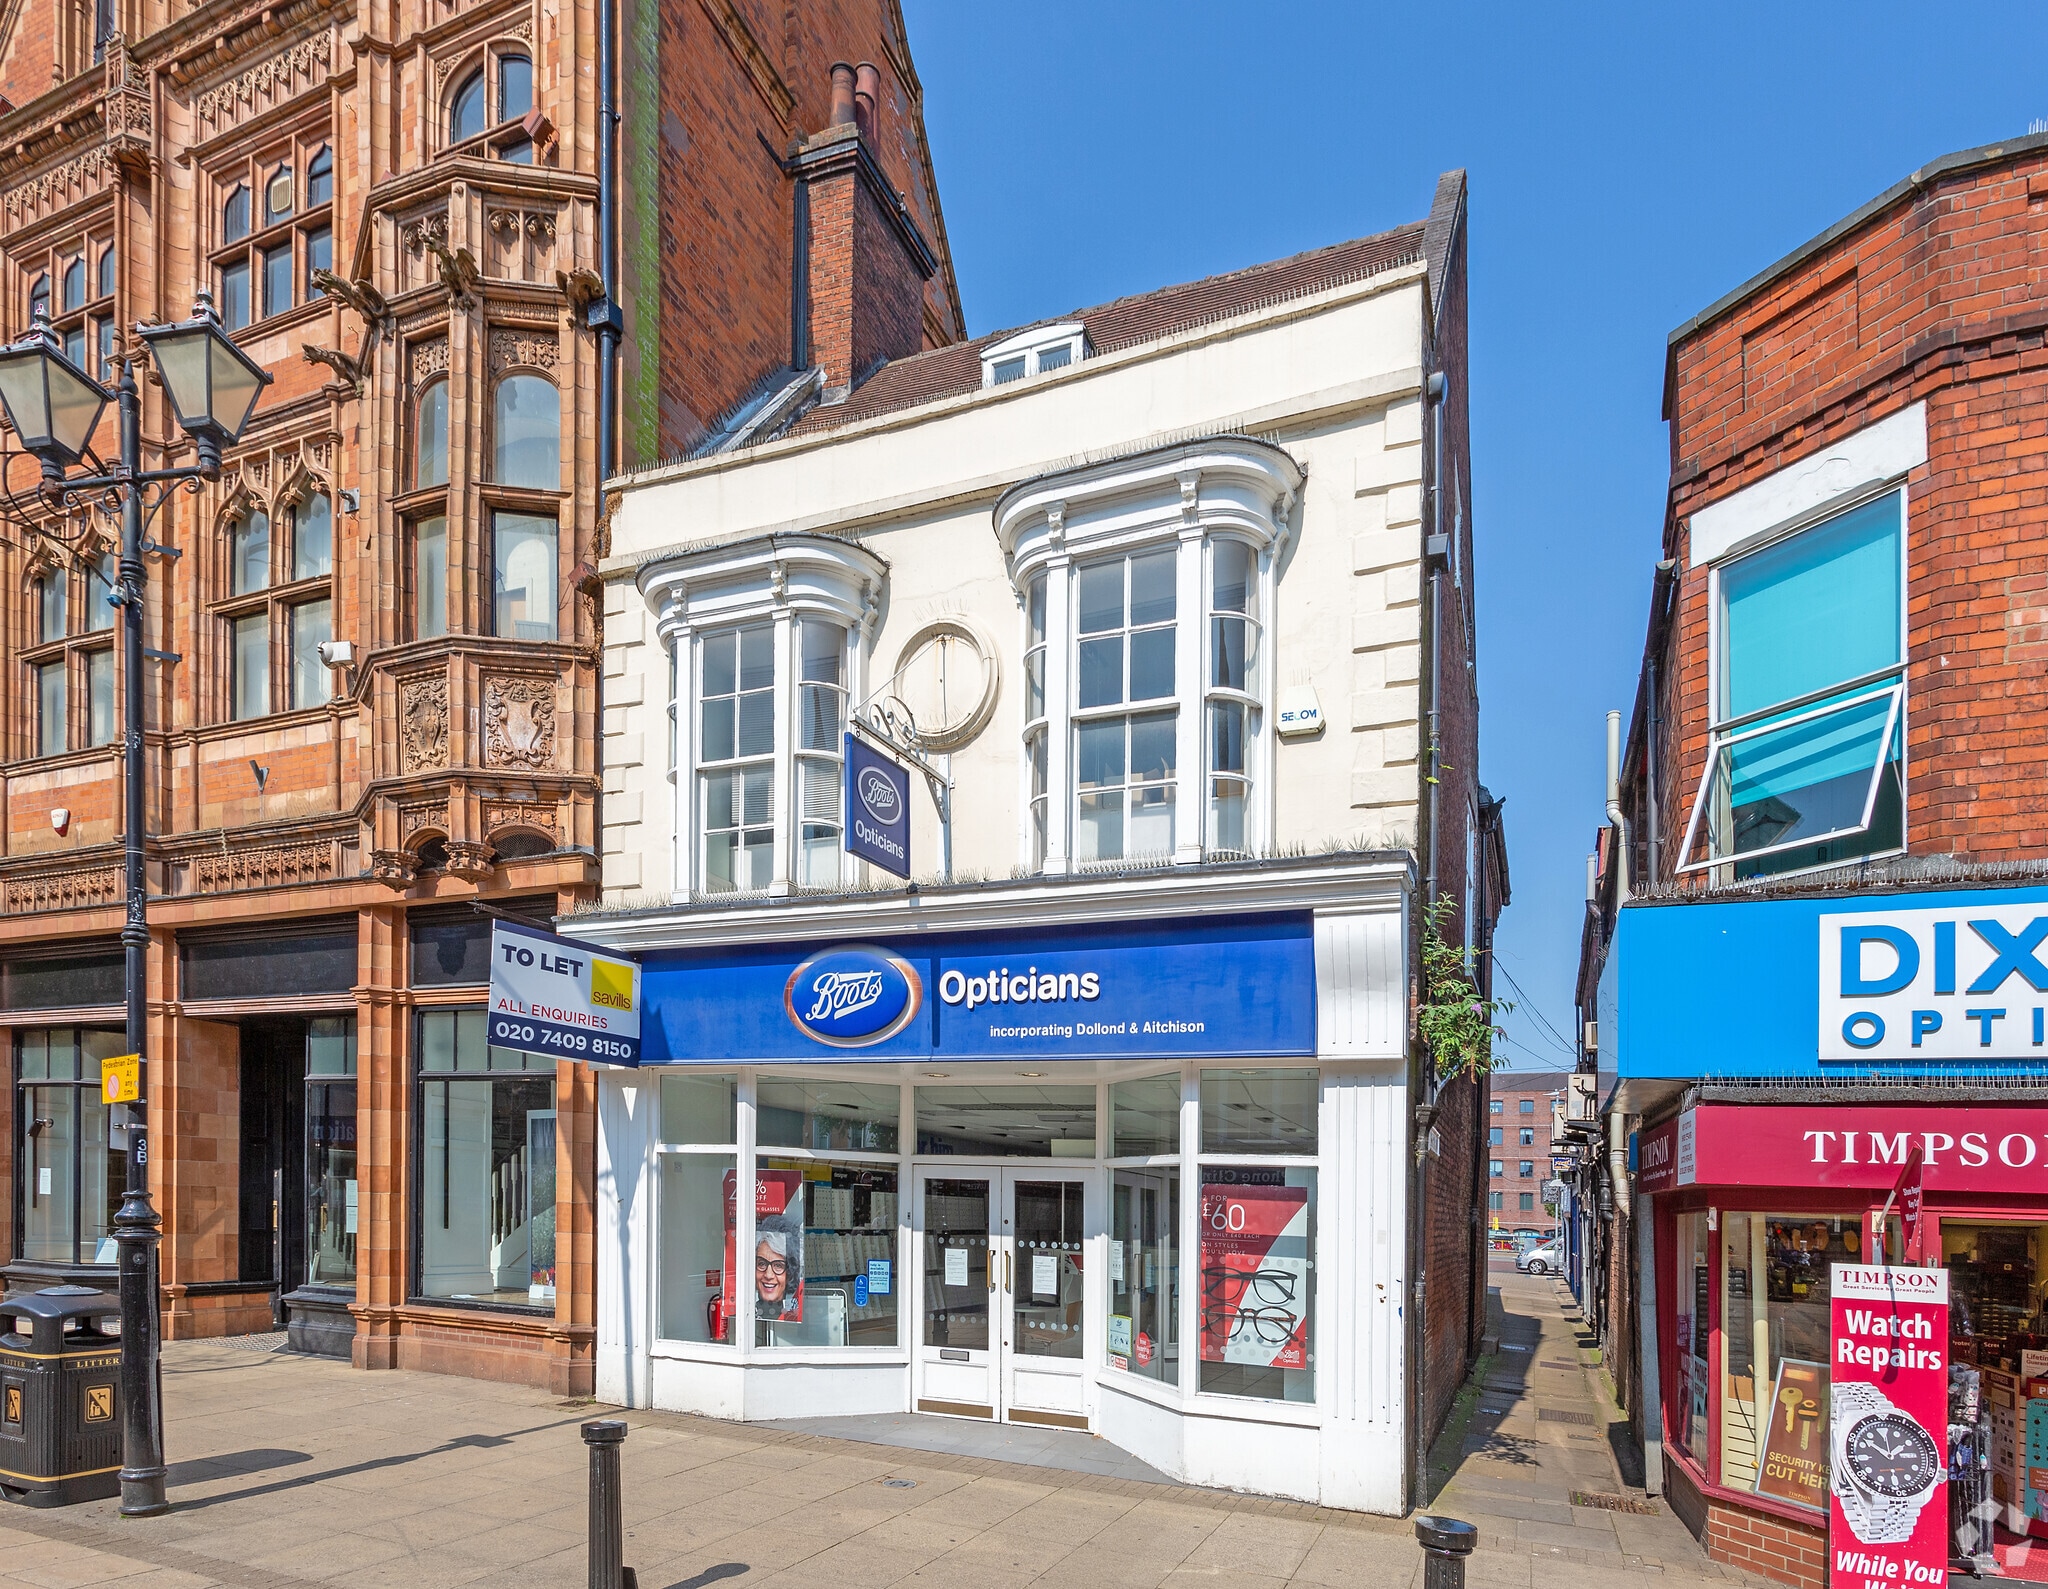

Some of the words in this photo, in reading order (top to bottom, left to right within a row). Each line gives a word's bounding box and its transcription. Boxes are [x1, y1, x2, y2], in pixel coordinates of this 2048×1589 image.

[865, 777, 895, 808] Boots
[855, 819, 904, 860] Opticians
[501, 943, 534, 966] TO
[540, 953, 583, 978] LET
[592, 991, 631, 1009] savills
[805, 970, 883, 1021] Boots
[939, 966, 1100, 1010] Opticians
[497, 998, 527, 1014] ALL
[531, 1004, 608, 1029] ENQUIRIES
[990, 1024, 1073, 1038] incorporating
[1076, 1022, 1125, 1035] Dollond
[1129, 1022, 1139, 1034] &
[1143, 1020, 1205, 1033] Aitchison
[496, 1021, 535, 1042] 020
[541, 1029, 587, 1051] 7409
[592, 1038, 632, 1059] 8150
[137, 1139, 147, 1150] 3
[137, 1151, 147, 1163] B
[1642, 1134, 1669, 1169] TIMPSON
[1803, 1130, 2048, 1168] TIMPSO
[1203, 1203, 1245, 1231] £60
[1839, 1270, 1938, 1287] TIMPSON
[1845, 1309, 1932, 1340] Watch
[4, 1357, 26, 1368] LITTER
[76, 1357, 120, 1369] LITTER
[1838, 1338, 1942, 1373] Repairs
[1768, 1451, 1817, 1471] SECURITY
[1765, 1463, 1797, 1481] CUT
[1798, 1471, 1830, 1491] HER
[1836, 1550, 1899, 1579] While
[1904, 1559, 1944, 1585] You
